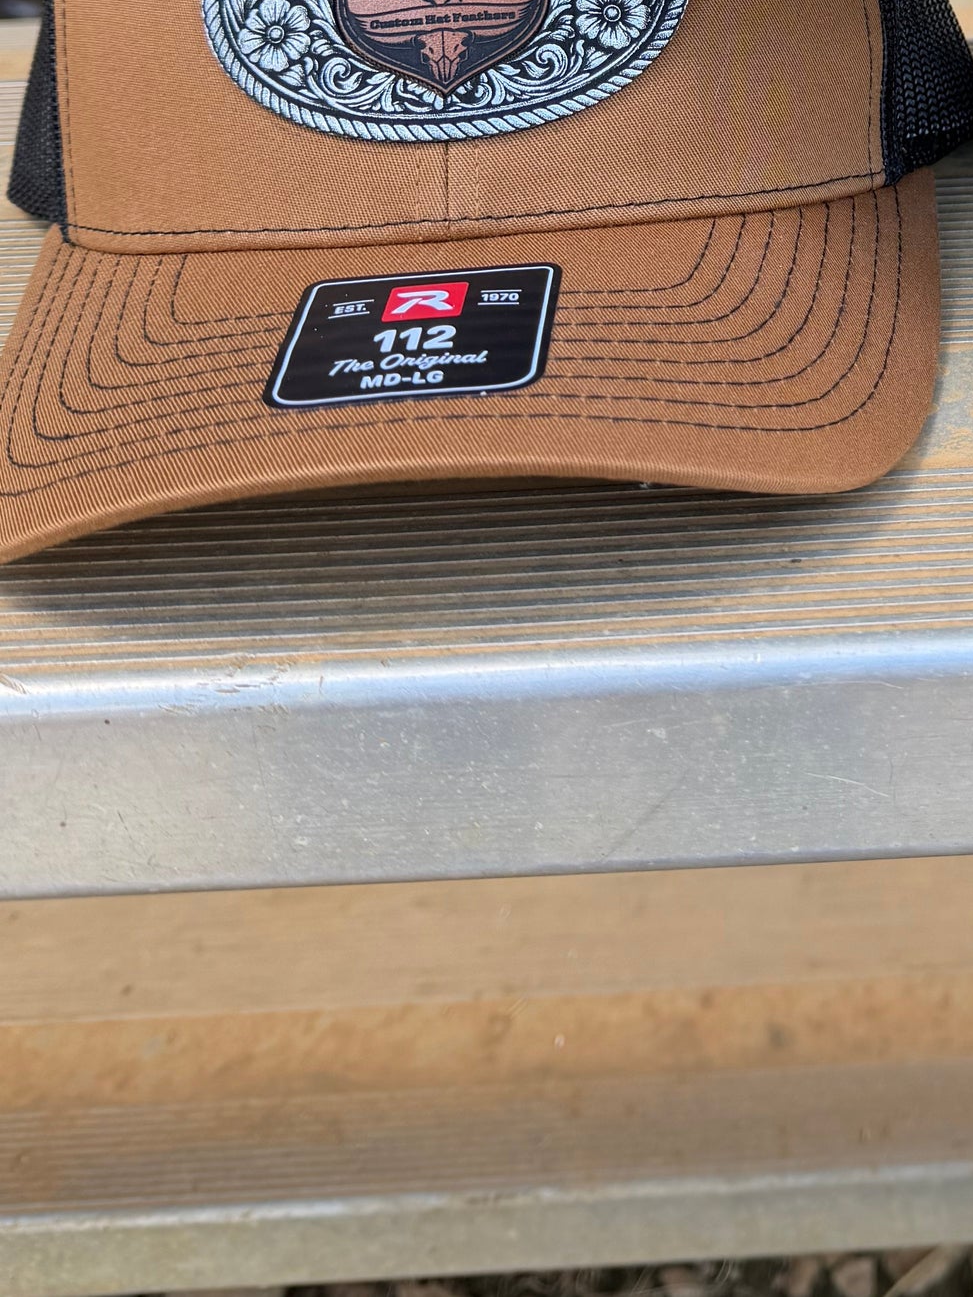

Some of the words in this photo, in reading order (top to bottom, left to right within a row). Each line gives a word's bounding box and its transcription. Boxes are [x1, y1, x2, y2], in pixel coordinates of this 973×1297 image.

[369, 17, 424, 30] Custom
[425, 14, 451, 25] Hat
[452, 10, 516, 23] Feathers
[481, 292, 520, 302] 1970
[333, 303, 368, 315] EST.
[373, 325, 457, 353] 112
[328, 358, 374, 377] The
[380, 350, 489, 371] Original
[360, 371, 444, 390] MD-LG
